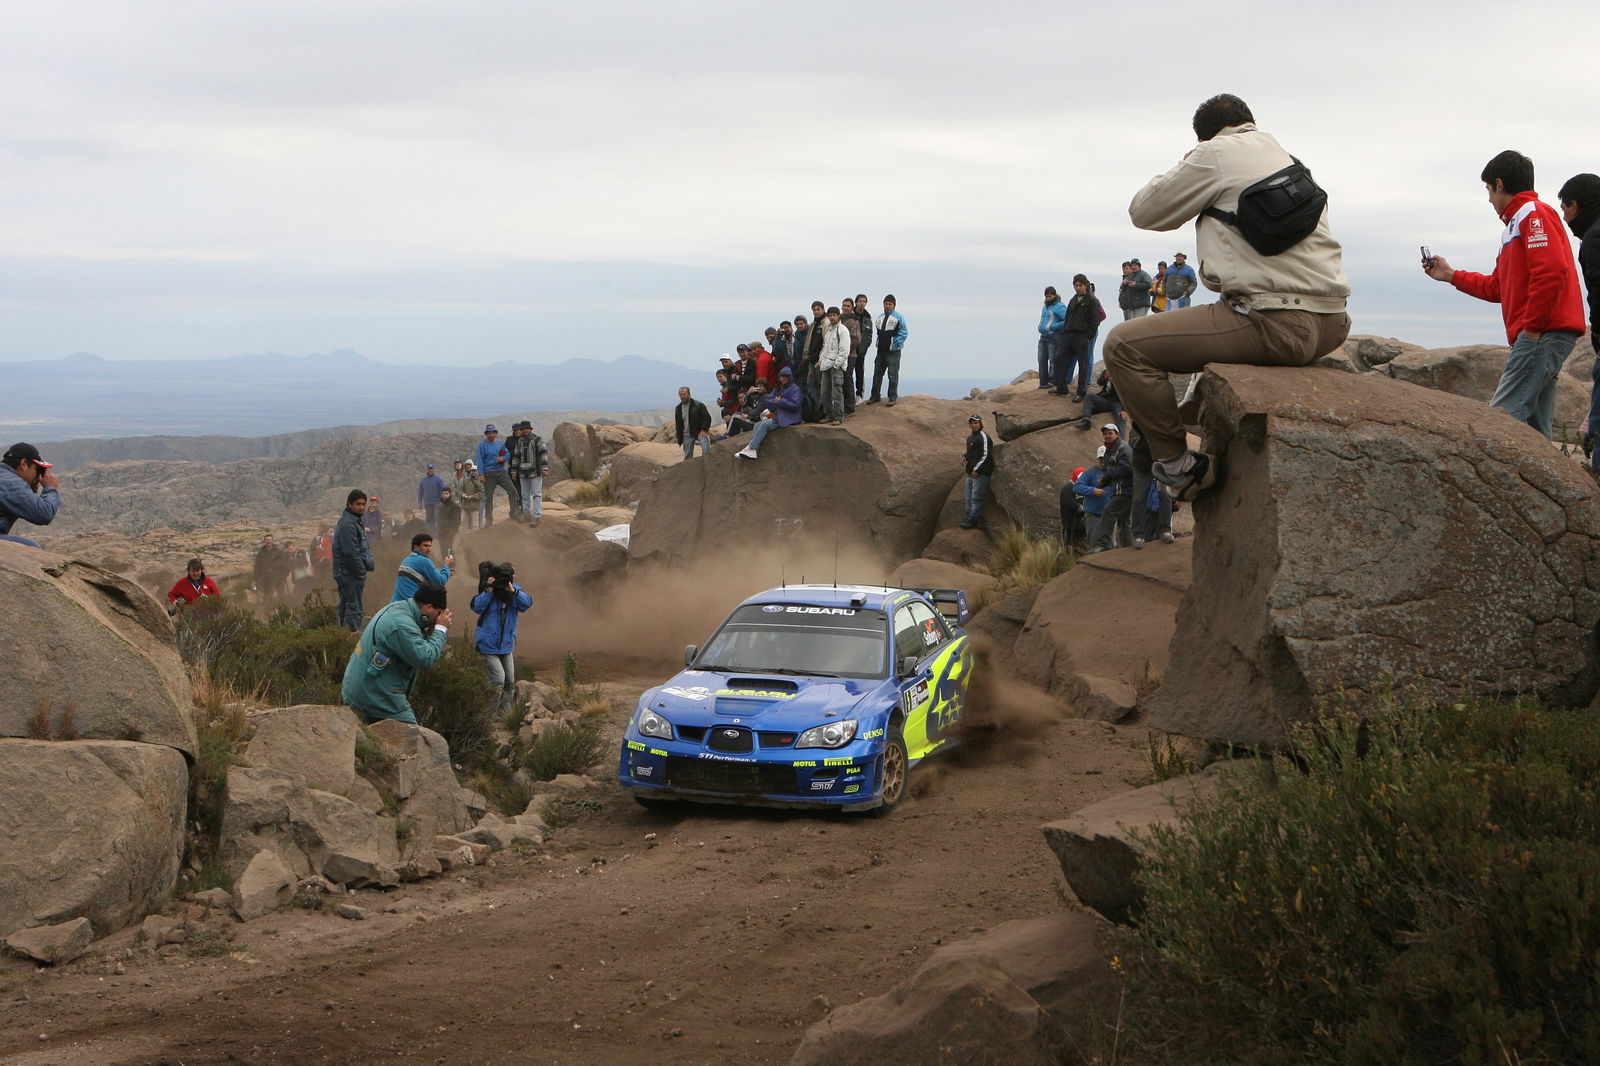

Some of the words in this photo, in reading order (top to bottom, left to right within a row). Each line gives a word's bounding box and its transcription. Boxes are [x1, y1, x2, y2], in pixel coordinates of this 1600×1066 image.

[785, 606, 856, 616] SUBARU
[863, 728, 884, 740] DENSO
[650, 748, 669, 757] MOTUL
[698, 752, 714, 760] STI
[824, 757, 853, 767] PIRELLI
[846, 767, 861, 775] PIAA
